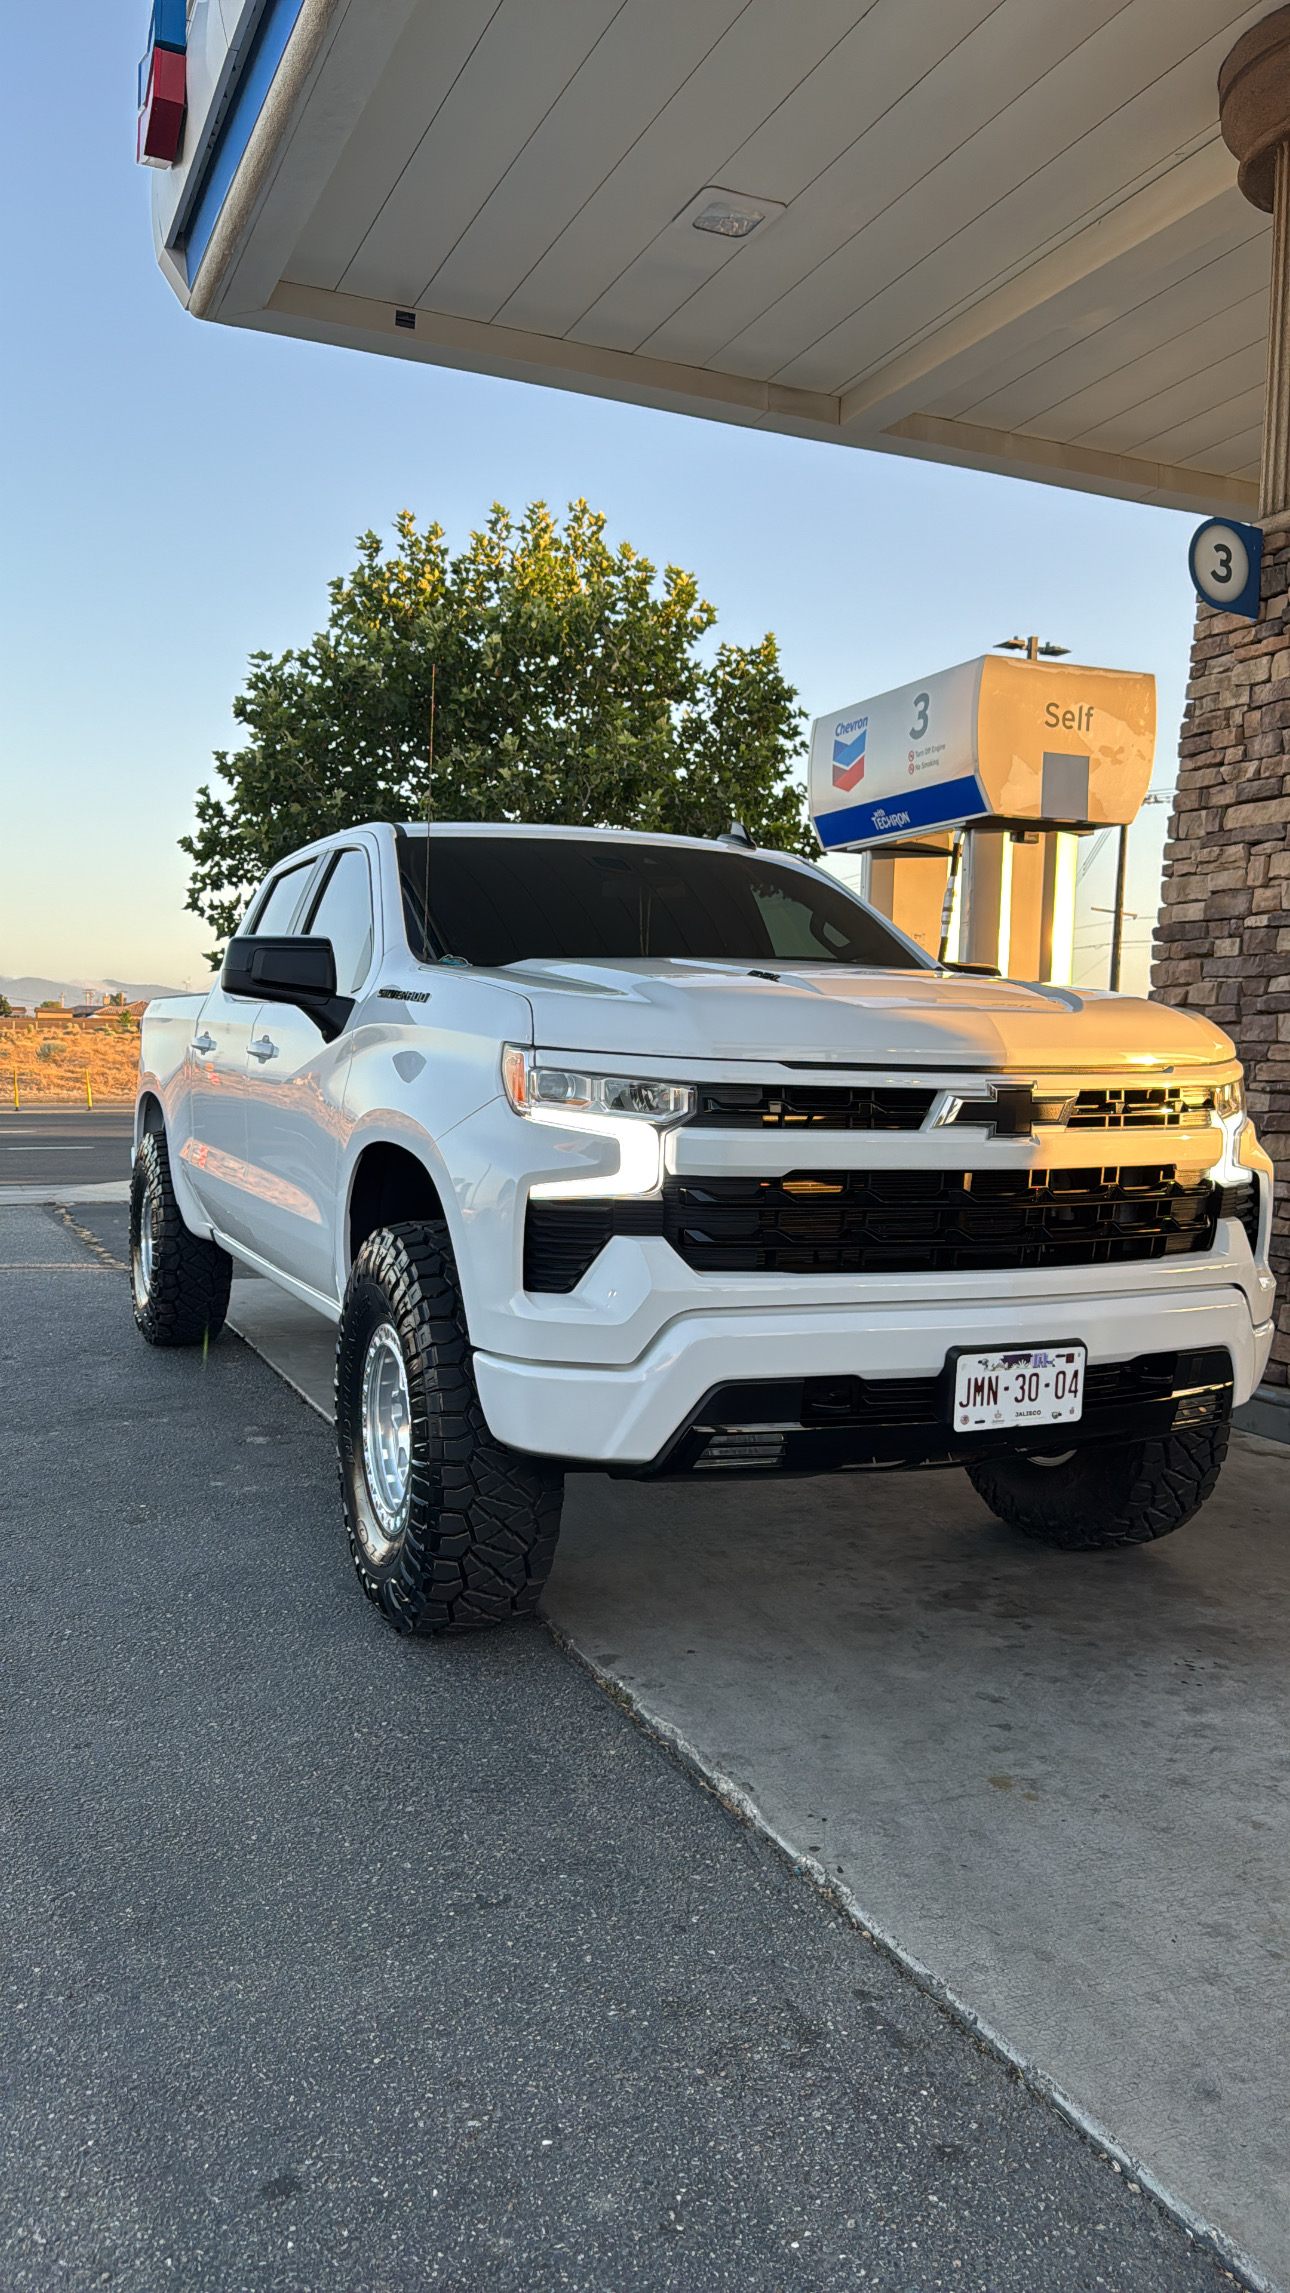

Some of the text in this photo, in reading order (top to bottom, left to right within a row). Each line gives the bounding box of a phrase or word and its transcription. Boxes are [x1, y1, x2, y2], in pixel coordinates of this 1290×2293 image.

[1210, 543, 1232, 584] 3
[835, 716, 868, 737] Chevron
[909, 692, 930, 740] 3
[1044, 702, 1094, 732] Self
[871, 811, 911, 830] TECHRON
[1015, 1410, 1042, 1418] JALISCO
